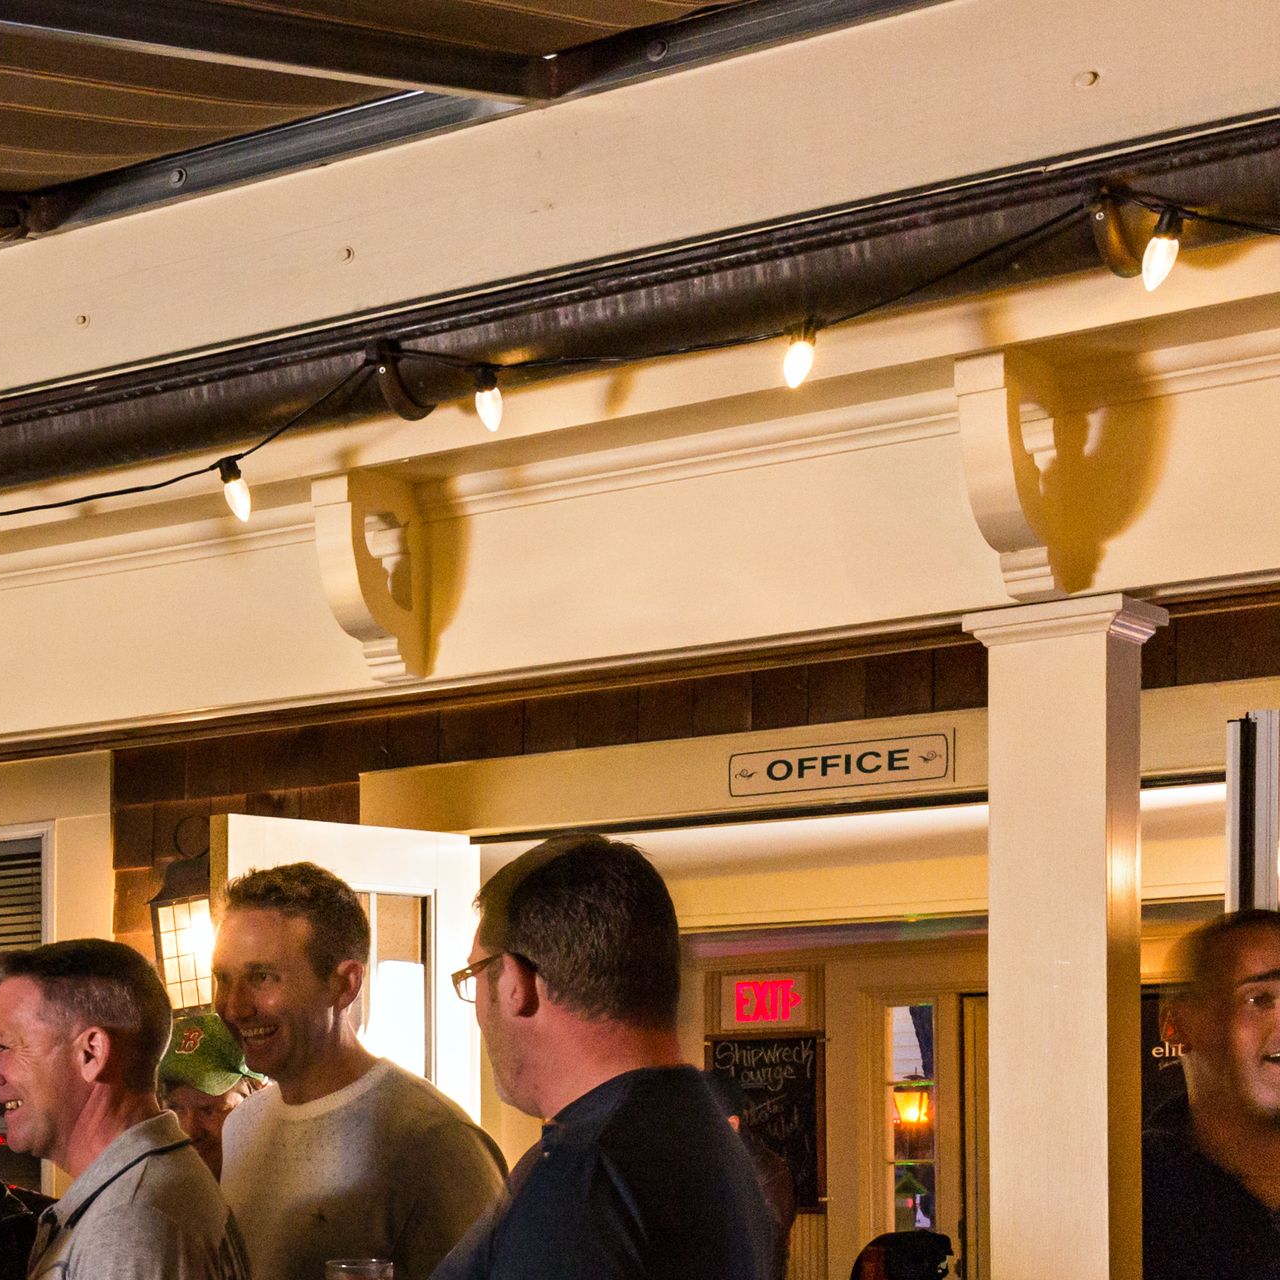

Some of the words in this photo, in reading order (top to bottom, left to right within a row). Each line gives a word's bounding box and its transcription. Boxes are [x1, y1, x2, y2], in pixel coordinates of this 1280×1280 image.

[766, 747, 911, 782] OFFICE
[735, 978, 795, 1023] EXIT
[715, 1039, 814, 1079] Shipwreck
[1151, 1041, 1185, 1058] elit
